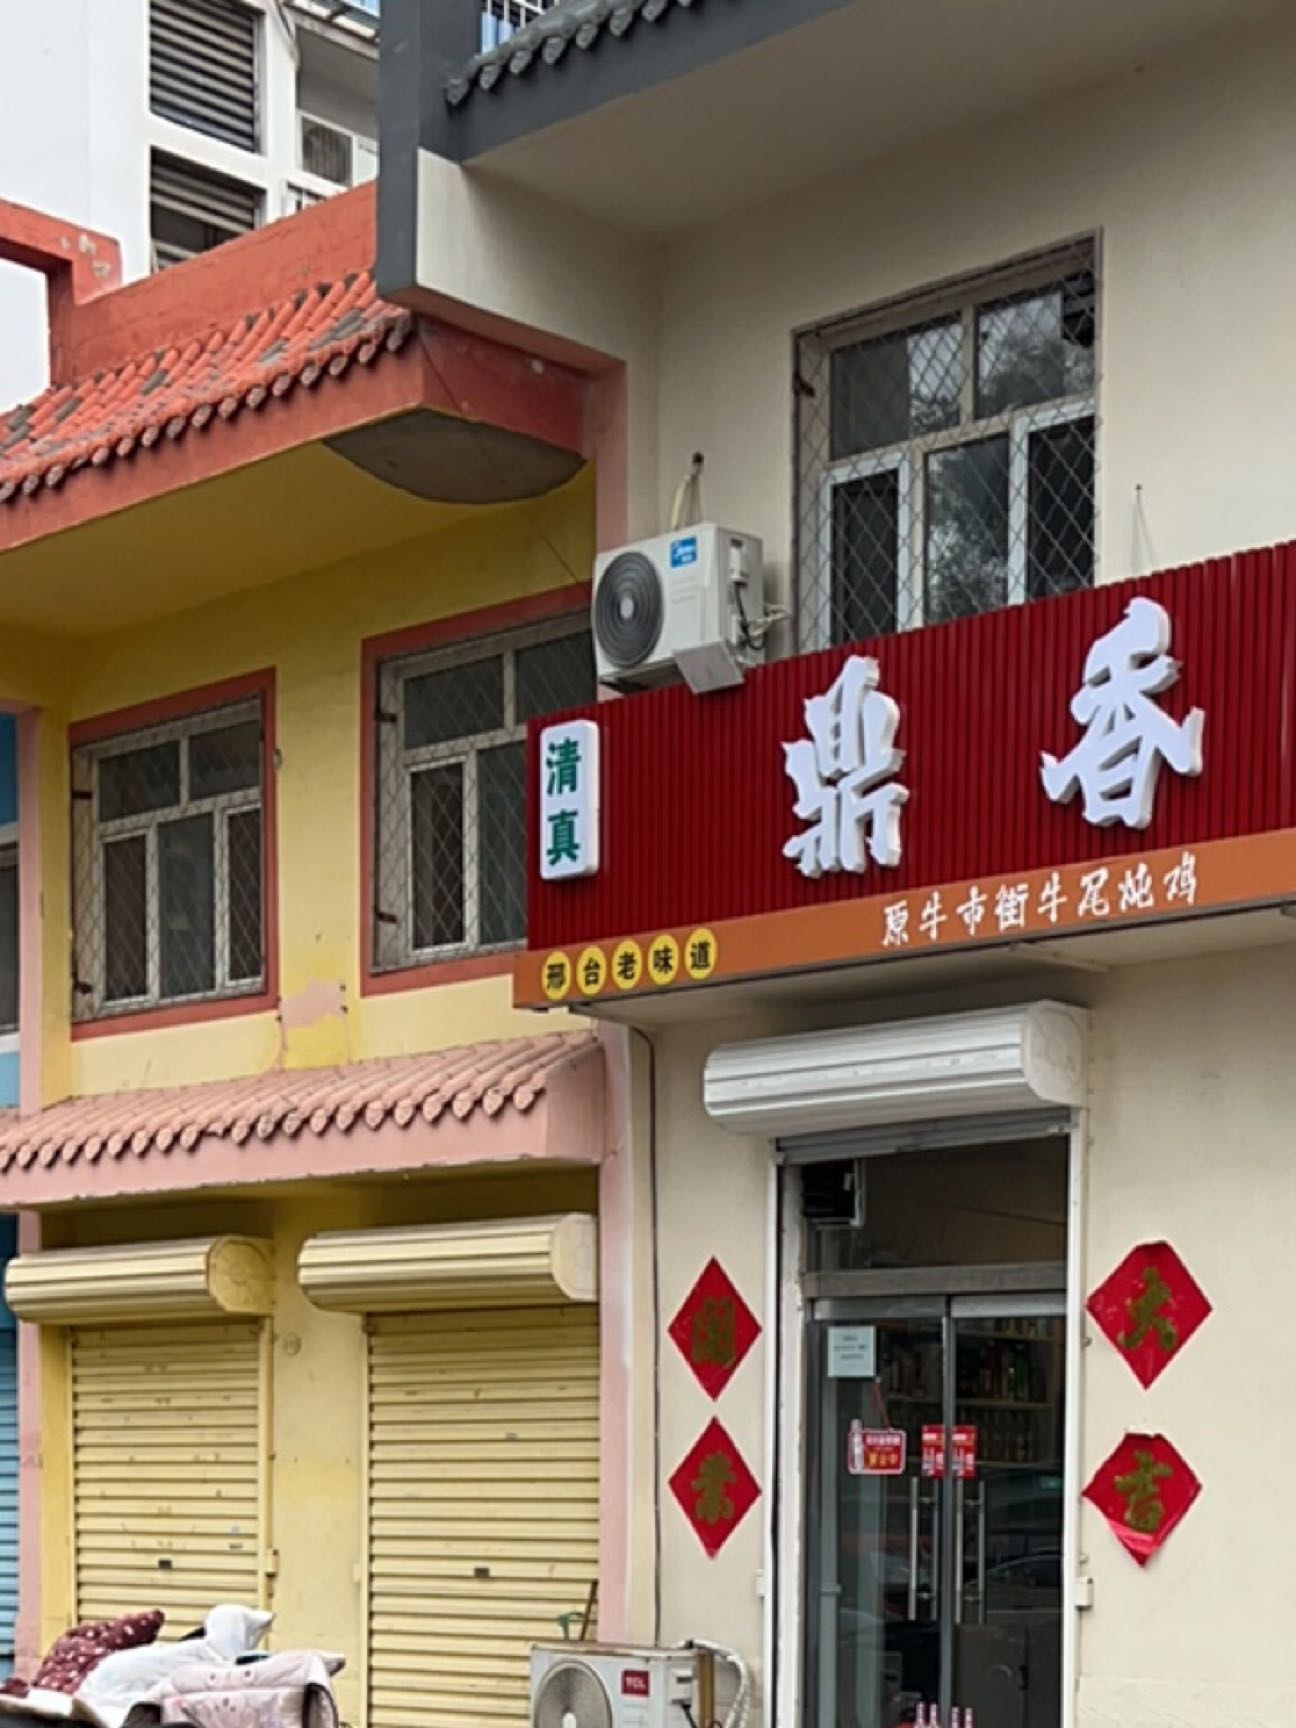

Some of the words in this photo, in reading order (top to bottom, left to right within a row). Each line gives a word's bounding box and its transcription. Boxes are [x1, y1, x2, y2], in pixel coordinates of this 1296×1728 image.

[546, 737, 581, 865] 清真
[547, 941, 711, 989] 邢台老味道
